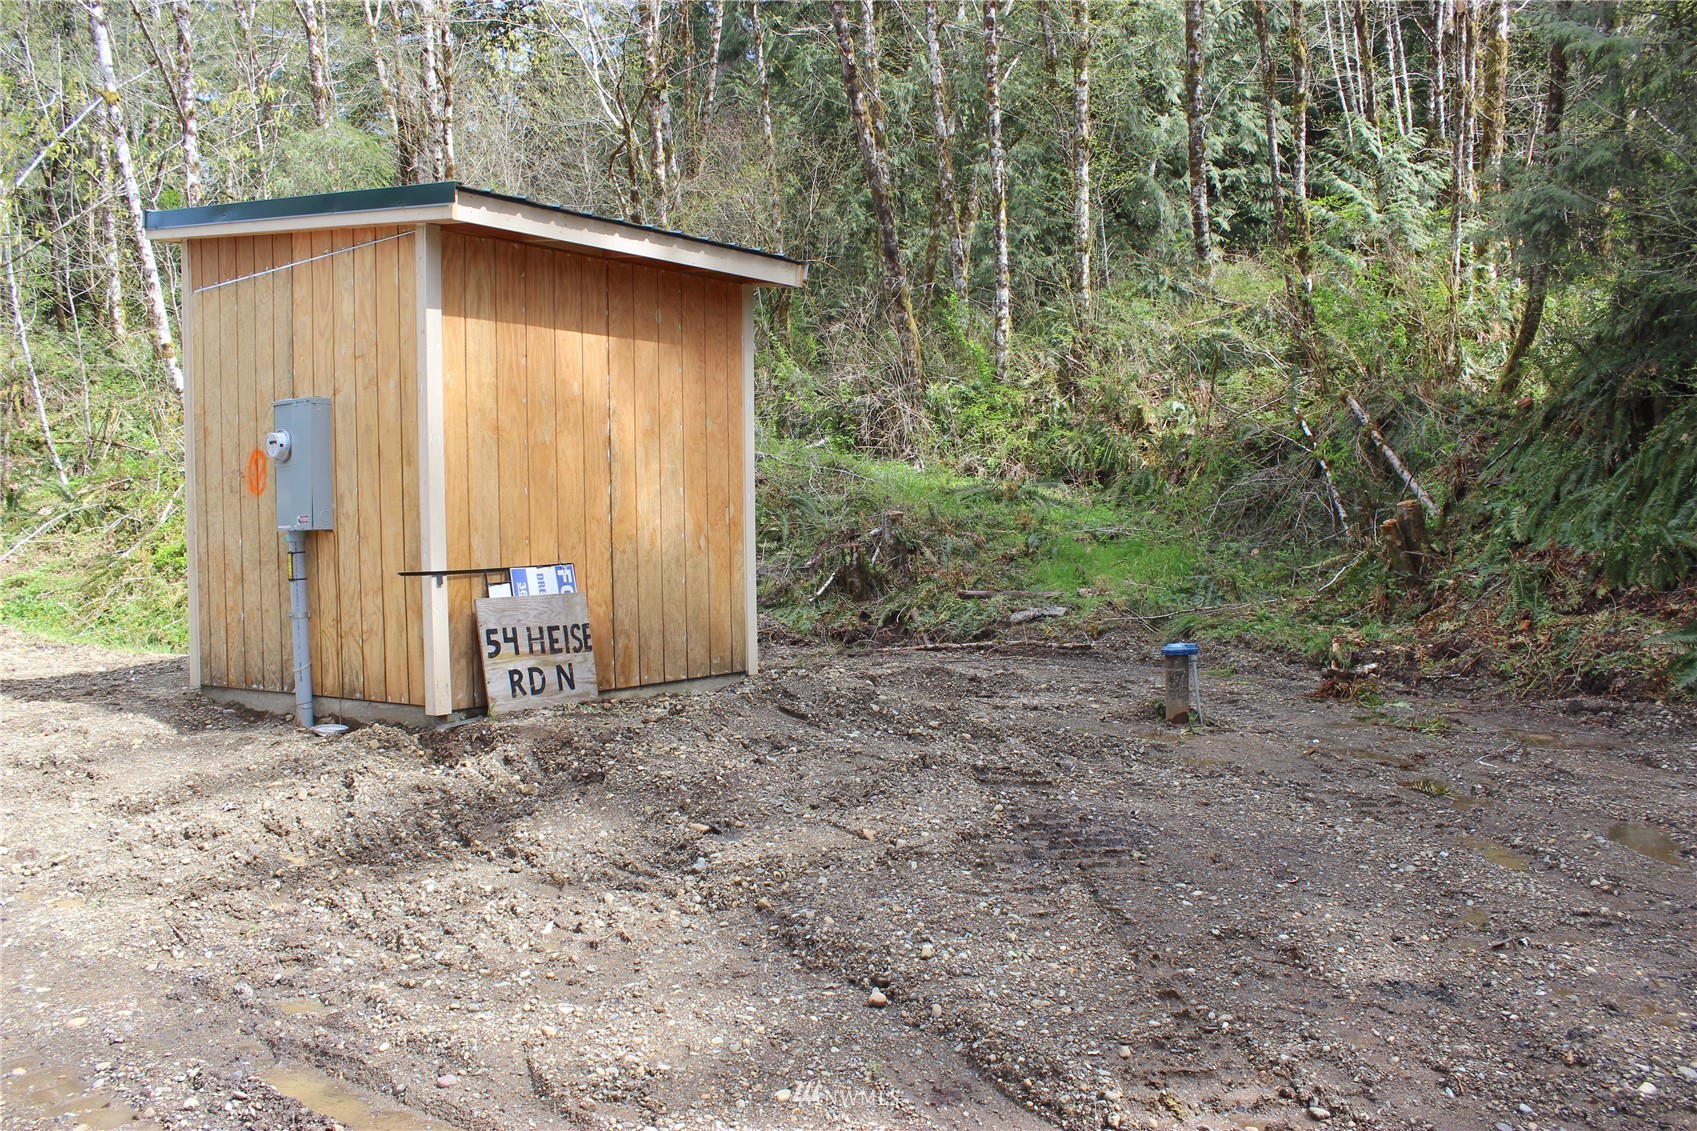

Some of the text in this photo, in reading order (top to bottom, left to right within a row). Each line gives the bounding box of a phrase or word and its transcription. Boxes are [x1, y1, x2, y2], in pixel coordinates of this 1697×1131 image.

[486, 623, 592, 658] 54 HEISE
[508, 663, 575, 698] RD N
